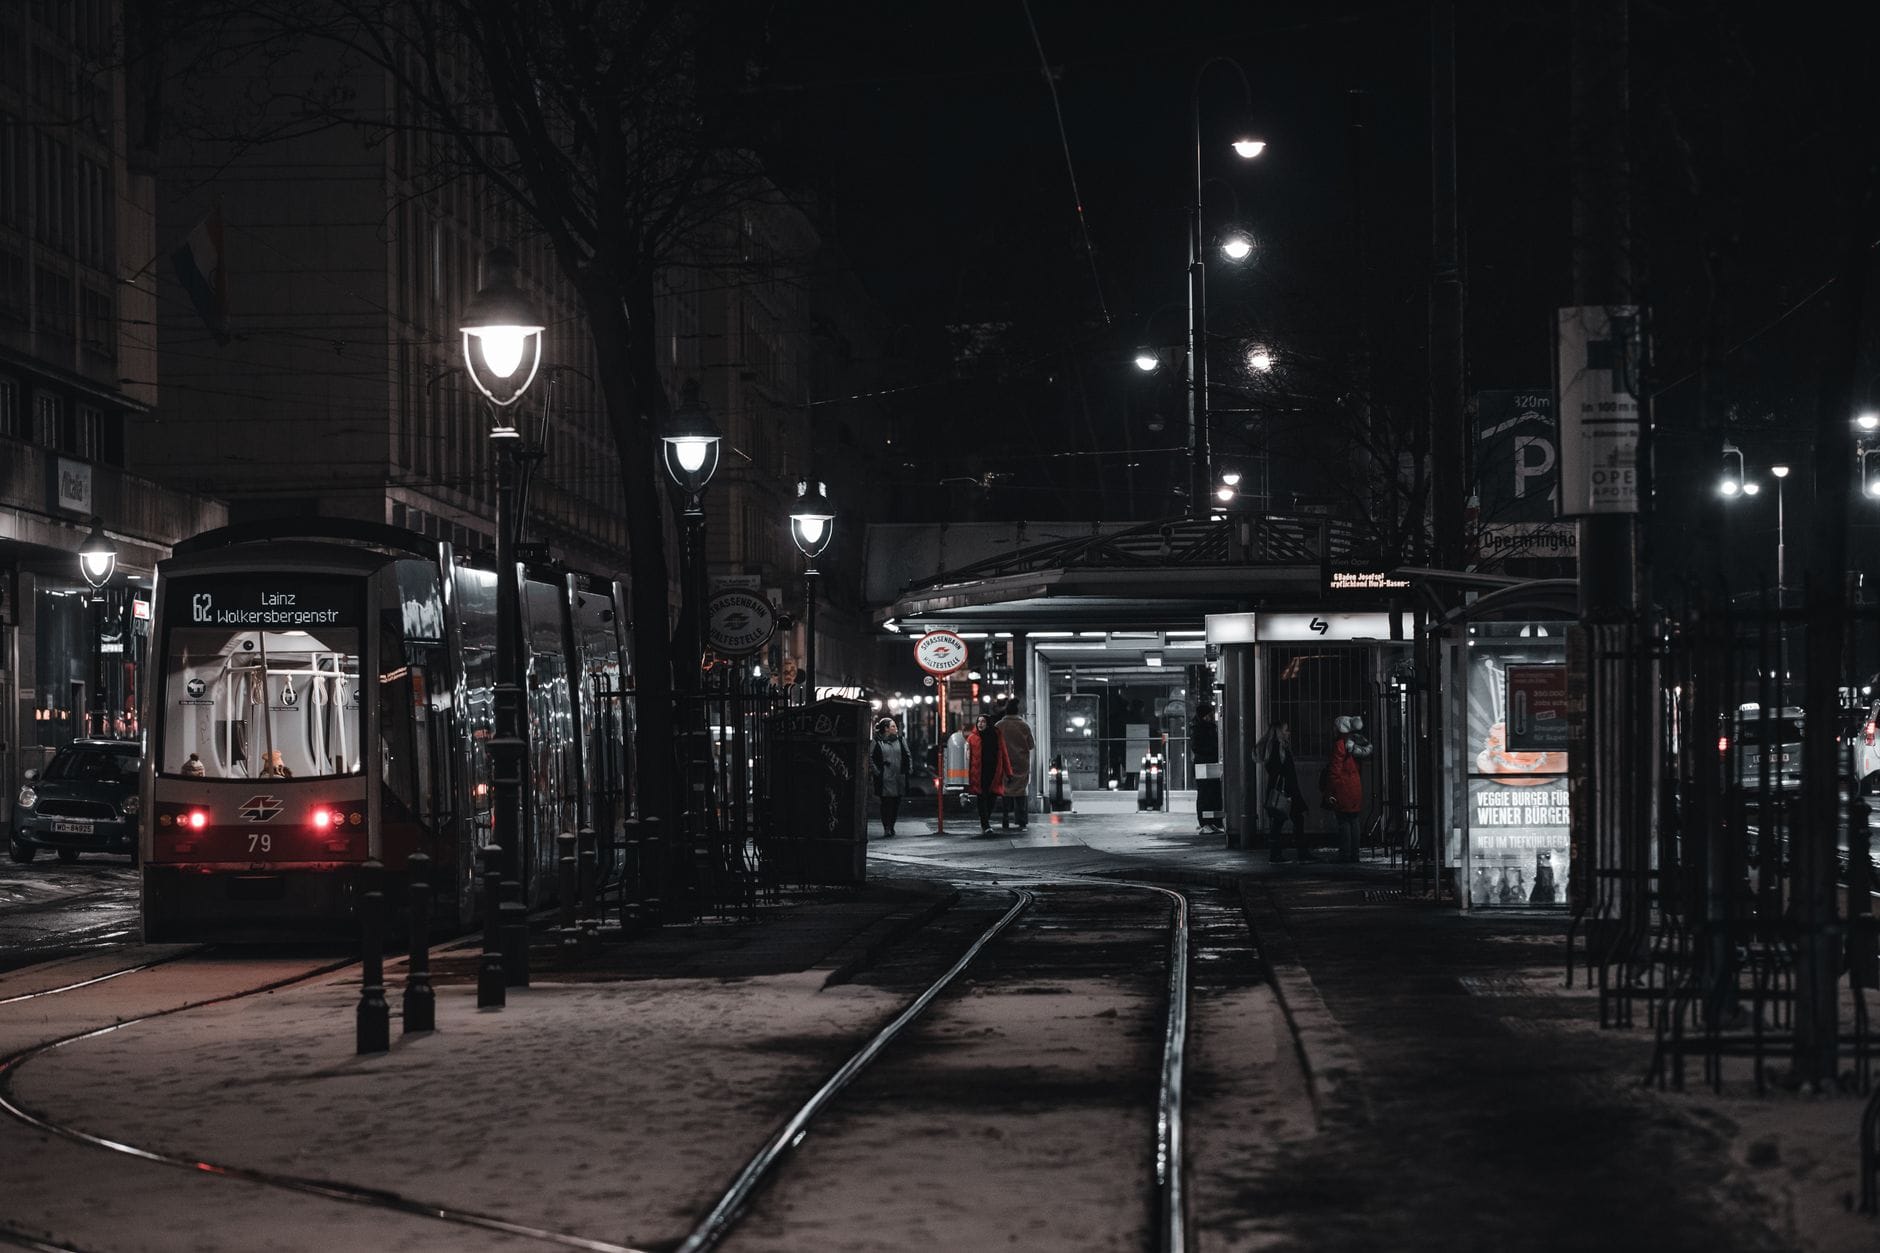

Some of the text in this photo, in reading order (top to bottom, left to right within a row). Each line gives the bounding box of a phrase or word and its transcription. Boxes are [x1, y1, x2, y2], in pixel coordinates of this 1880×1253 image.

[1515, 435, 1556, 498] P
[262, 592, 296, 605] Lainz
[193, 594, 338, 624] 62 Wolkersbergenstr
[921, 636, 962, 651] STRASSENBAHN
[924, 656, 961, 669] HALTESTELLE
[1477, 790, 1569, 806] VEGGIE BURGER FÜR
[1478, 805, 1570, 825] WIENER BÜRGER
[248, 834, 271, 853] 79
[1478, 836, 1494, 848] NEU
[1496, 836, 1507, 848] IM
